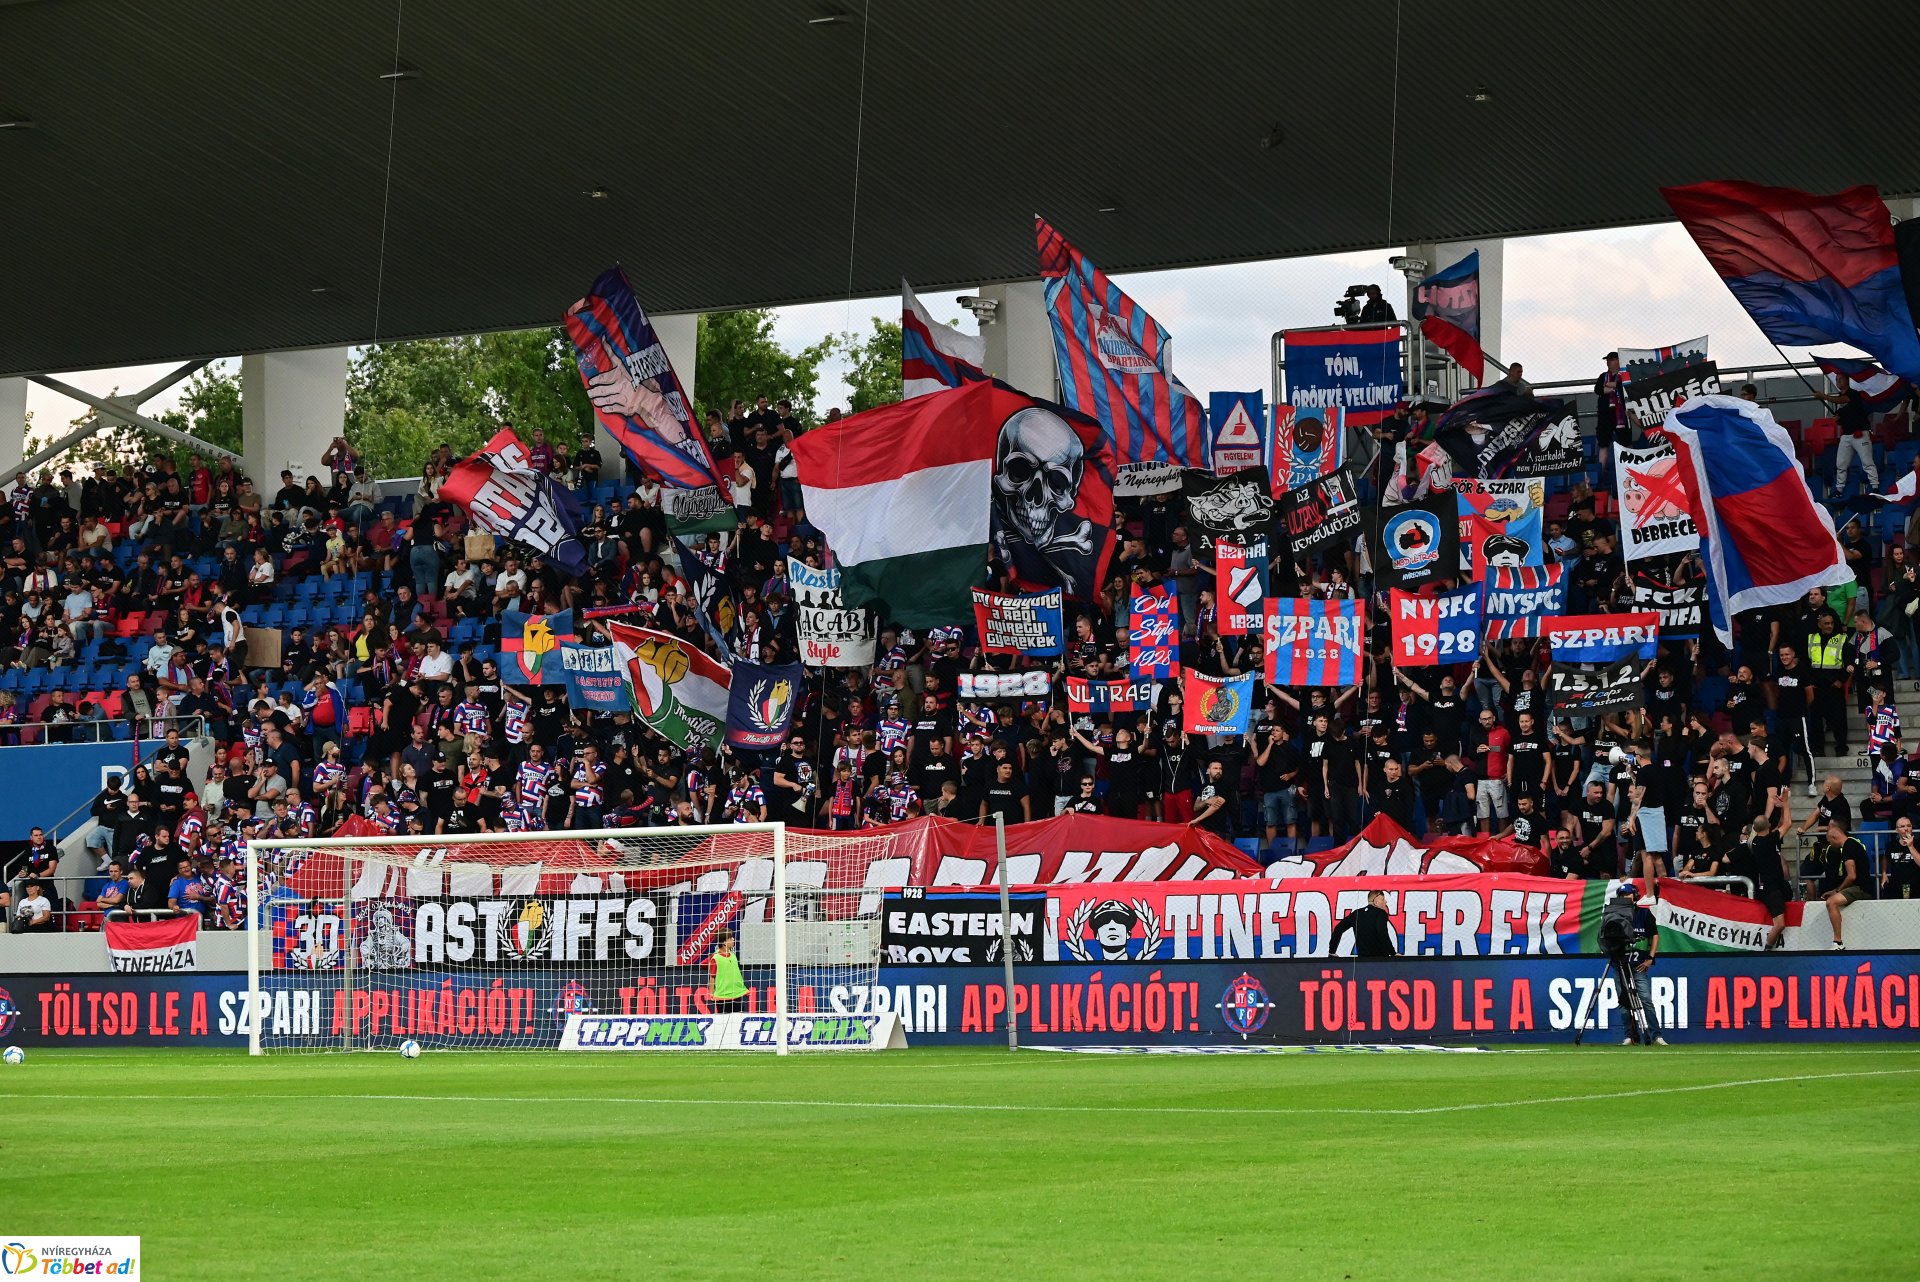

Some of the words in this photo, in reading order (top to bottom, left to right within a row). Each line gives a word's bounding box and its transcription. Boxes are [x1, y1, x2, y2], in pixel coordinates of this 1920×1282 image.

[1325, 352, 1363, 379] TÓNI,
[1292, 384, 1342, 408] ÖRÖKKÉ
[1344, 382, 1398, 406] VELÜNK!
[1224, 453, 1254, 461] FIGYELEM!
[1476, 483, 1485, 494] &
[1489, 482, 1525, 494] SZPARI
[1218, 543, 1266, 559] SZPARI
[1135, 592, 1173, 613] Old
[1400, 593, 1476, 619] NYSFC
[1487, 589, 1561, 615] NYSFC
[1635, 587, 1697, 605] FCK
[1130, 619, 1174, 645] Style
[1230, 614, 1263, 628] 1928
[1266, 615, 1360, 656] SZPARI
[1401, 630, 1475, 656] 1928
[1549, 624, 1656, 649] SZPARI
[807, 640, 841, 665] Style
[1133, 650, 1173, 667] 1928
[1294, 649, 1339, 659] 1928
[959, 671, 1049, 697] 1928
[1067, 684, 1151, 703] ULTRAS
[1857, 759, 1868, 767] 06
[903, 887, 922, 899] 1928
[294, 914, 340, 953] 30
[889, 912, 1033, 936] EASTERN
[1668, 910, 1785, 949] NYÍREGYHÁA
[39, 983, 138, 1036] TÖLTSD
[149, 991, 180, 1036] LE
[190, 991, 208, 1036] A
[219, 990, 320, 1035] SZPARI
[331, 977, 535, 1036] APPLIKÁCIÓT!
[962, 970, 1199, 1033] APPLIKÁCIÓT!
[1300, 969, 1436, 1031] TÖLTSD
[1453, 979, 1494, 1031] LE
[1509, 979, 1534, 1030] A
[1548, 977, 1688, 1030] SZPRI
